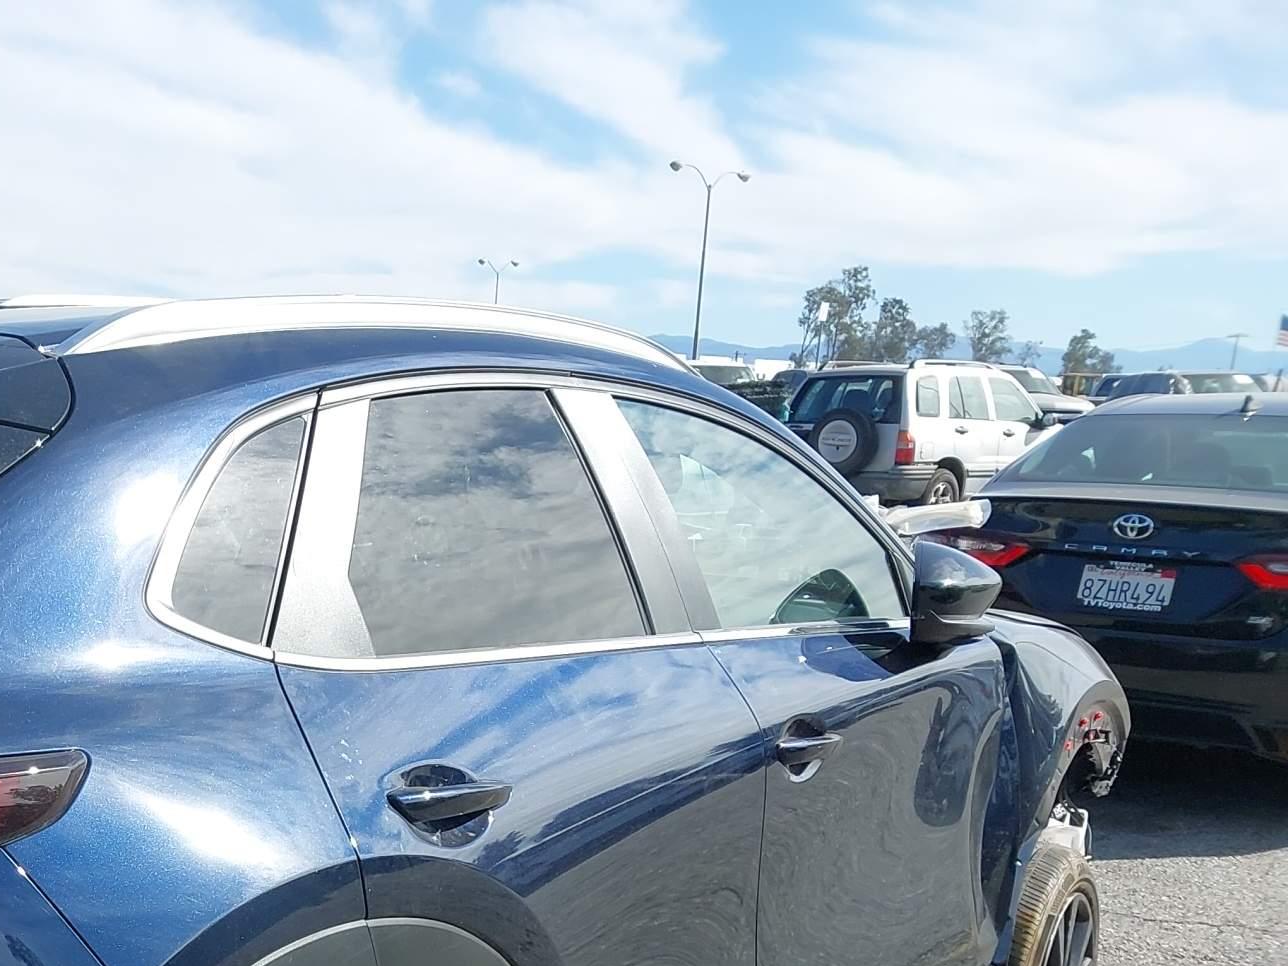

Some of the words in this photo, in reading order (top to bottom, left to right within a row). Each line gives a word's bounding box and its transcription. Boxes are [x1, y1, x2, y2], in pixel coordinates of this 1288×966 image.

[1064, 543, 1201, 558] CAMRY
[1081, 578, 1167, 604] 8ZHR494
[1082, 599, 1162, 612] TVToyota.com
